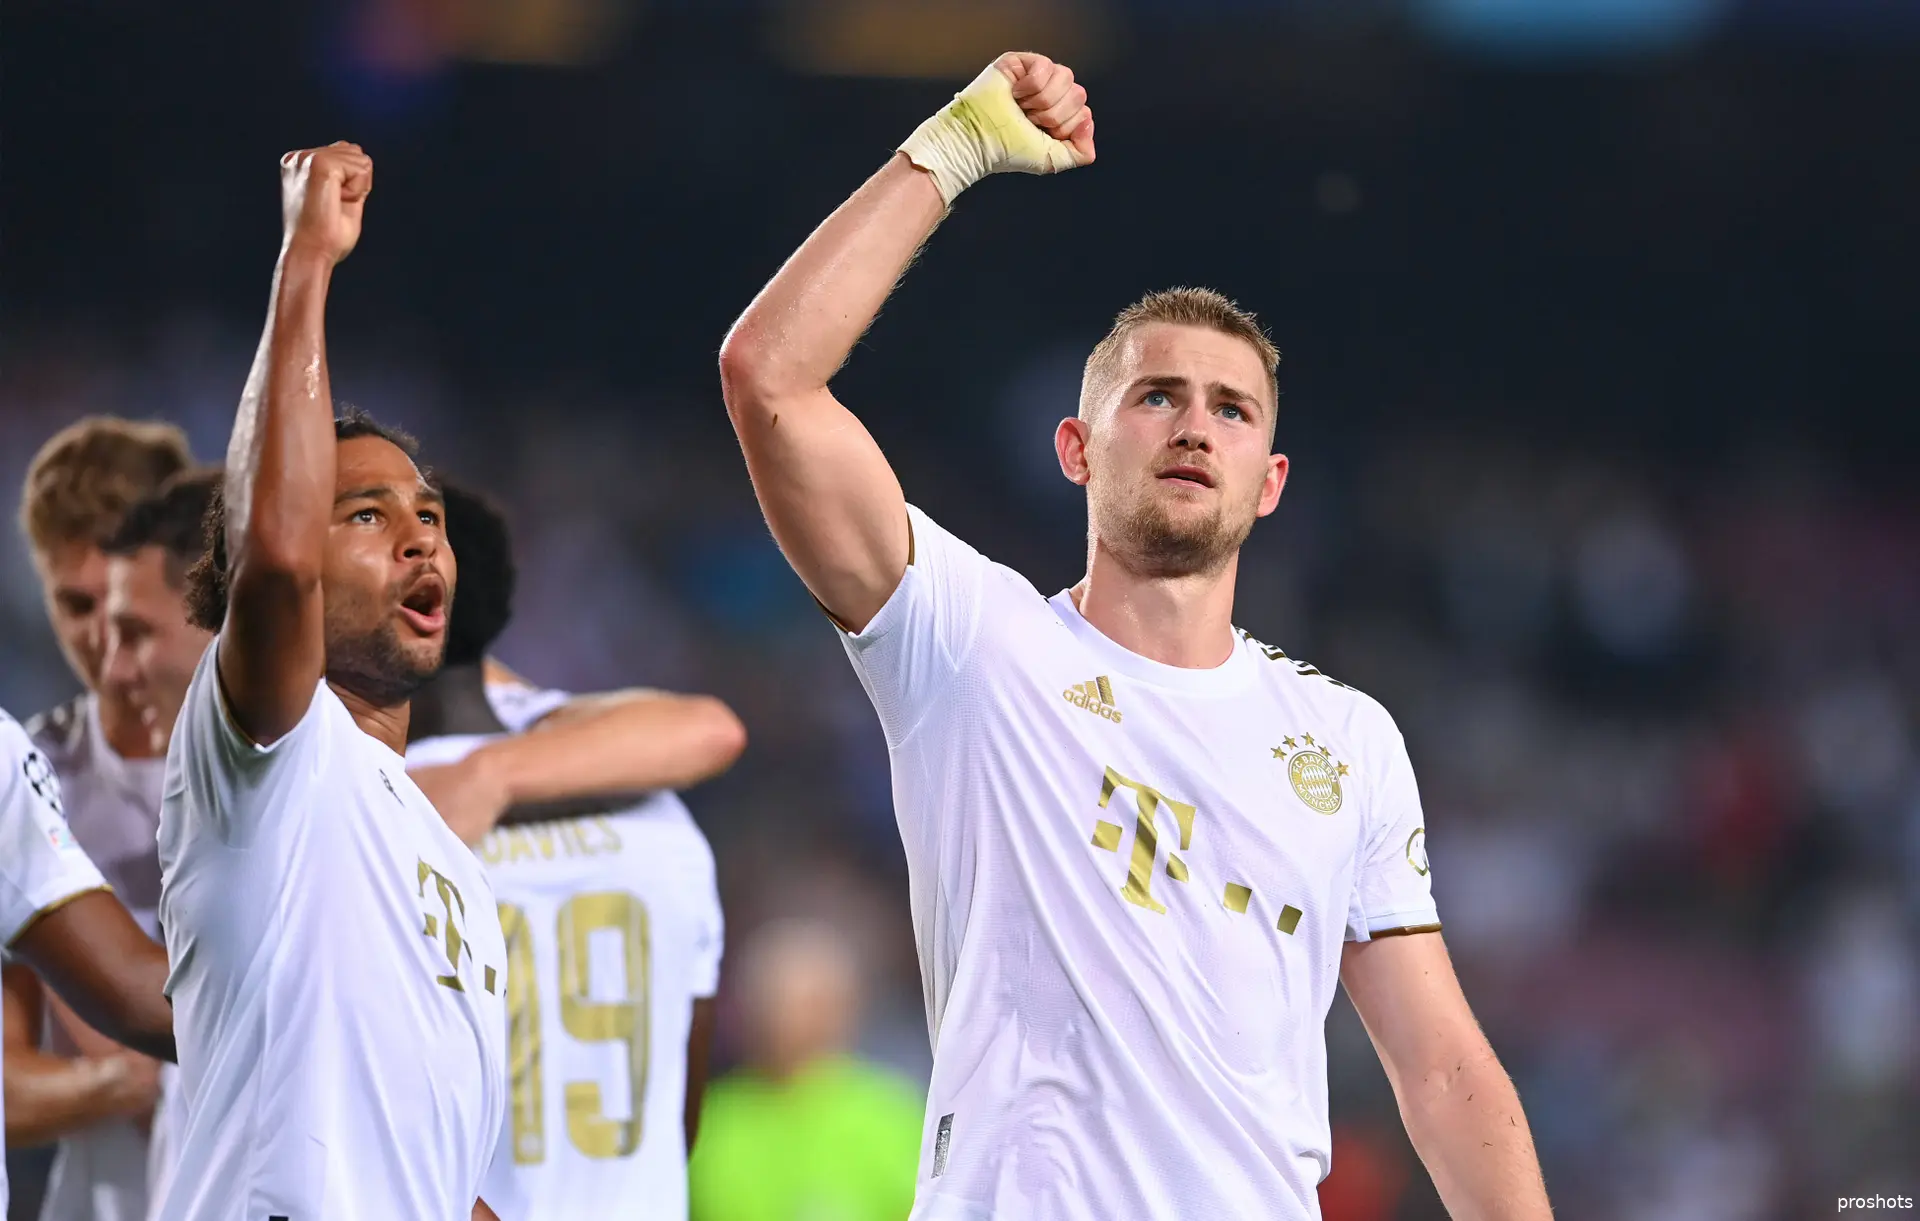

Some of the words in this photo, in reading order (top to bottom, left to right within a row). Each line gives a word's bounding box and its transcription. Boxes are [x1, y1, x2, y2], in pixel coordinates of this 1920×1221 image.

[1063, 689, 1122, 723] adidas
[1293, 761, 1302, 773] FC
[1301, 755, 1336, 782] BAYERN
[498, 891, 651, 1164] 19
